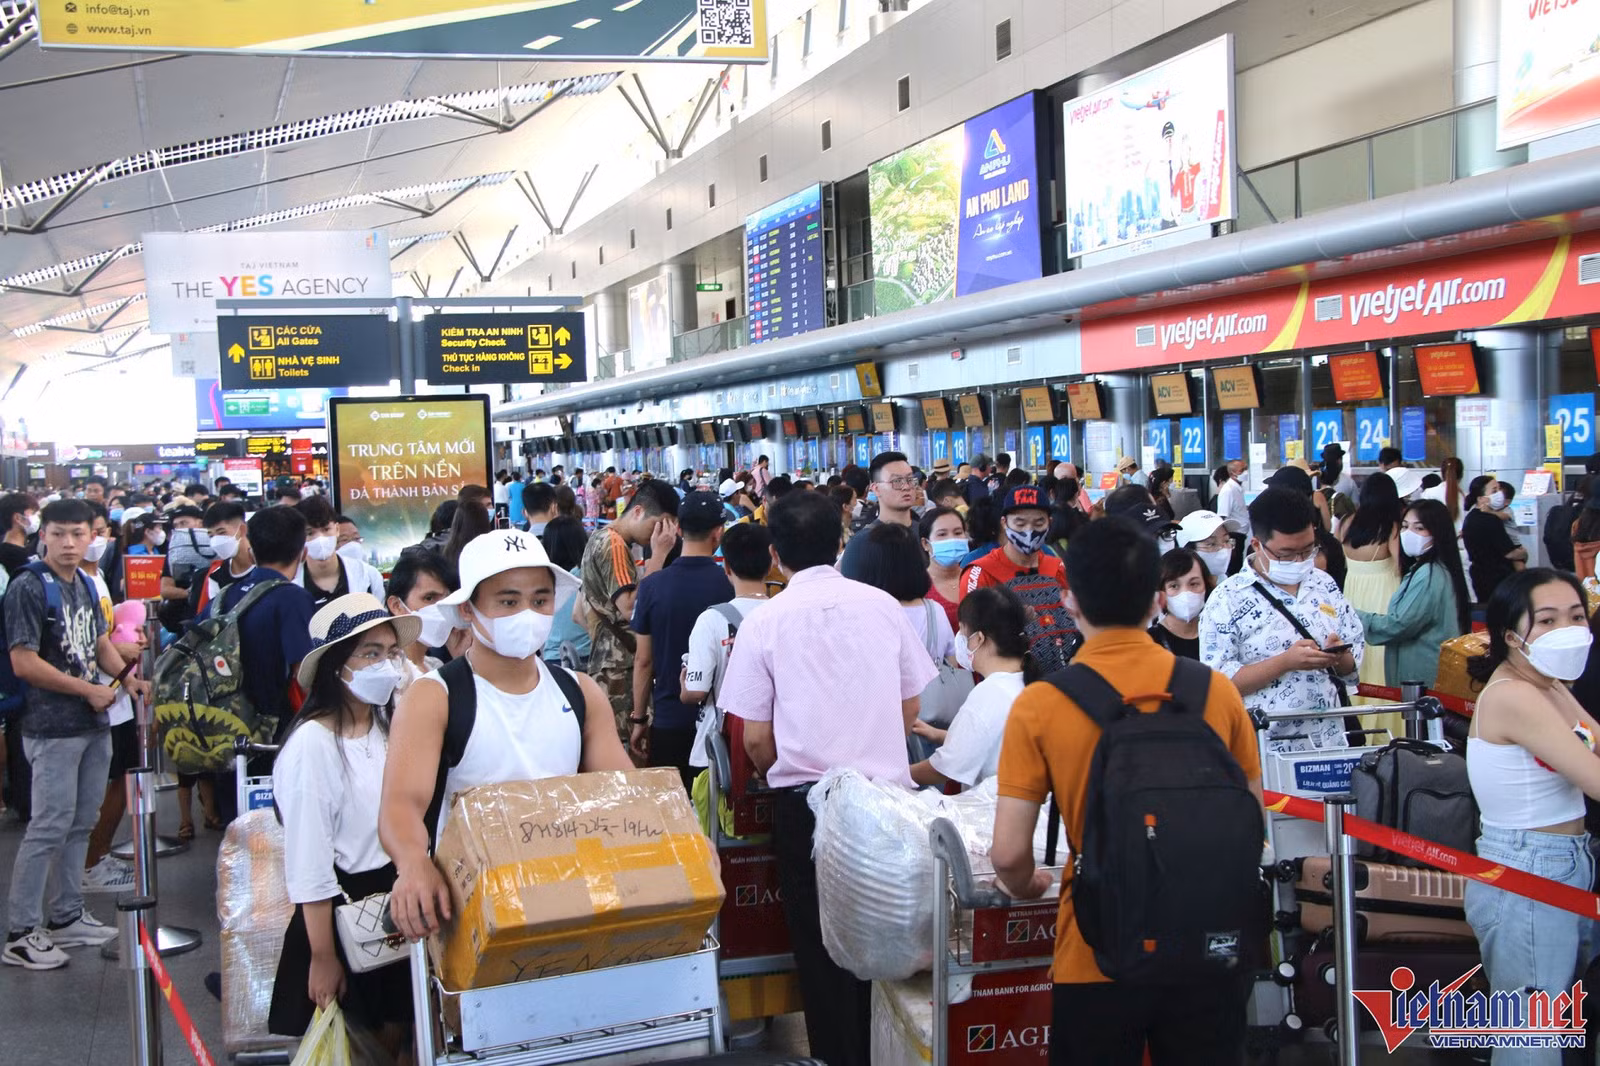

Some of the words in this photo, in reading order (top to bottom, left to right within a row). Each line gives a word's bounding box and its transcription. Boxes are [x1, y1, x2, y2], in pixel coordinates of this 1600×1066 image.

[86, 4, 150, 18] info@taj.vn
[87, 26, 151, 37] www.taj.vn
[966, 195, 979, 219] AN
[980, 187, 1000, 214] PHU
[1001, 178, 1029, 207] LAND
[172, 281, 213, 298] THE
[219, 274, 274, 297] YES
[281, 277, 369, 296] AGENCY
[466, 328, 483, 336] TRA
[485, 328, 499, 336] AN
[501, 327, 523, 336] NINH
[277, 337, 290, 346] All
[292, 337, 319, 345] Gates
[441, 339, 477, 348] Security
[478, 338, 506, 347] Check
[278, 355, 300, 366] NHÀ
[316, 356, 340, 365] SINH
[443, 364, 470, 372] Check
[472, 364, 480, 372] in
[279, 368, 309, 377] Toilets
[1555, 407, 1590, 443] 25
[1152, 428, 1167, 454] 21
[1184, 427, 1202, 454] 22
[1359, 418, 1383, 450] 24
[347, 442, 403, 457] TRUNG
[407, 440, 441, 455] TÂM
[858, 443, 867, 462] 15
[935, 440, 945, 460] 17
[953, 438, 965, 460] 18
[1053, 433, 1068, 457] 20
[368, 461, 417, 481] TRÊN
[373, 485, 418, 498] THÀNH
[503, 535, 528, 552] NY
[1300, 764, 1331, 774] BIZMAN
[995, 986, 1015, 996] BANK
[1015, 985, 1029, 993] FOR
